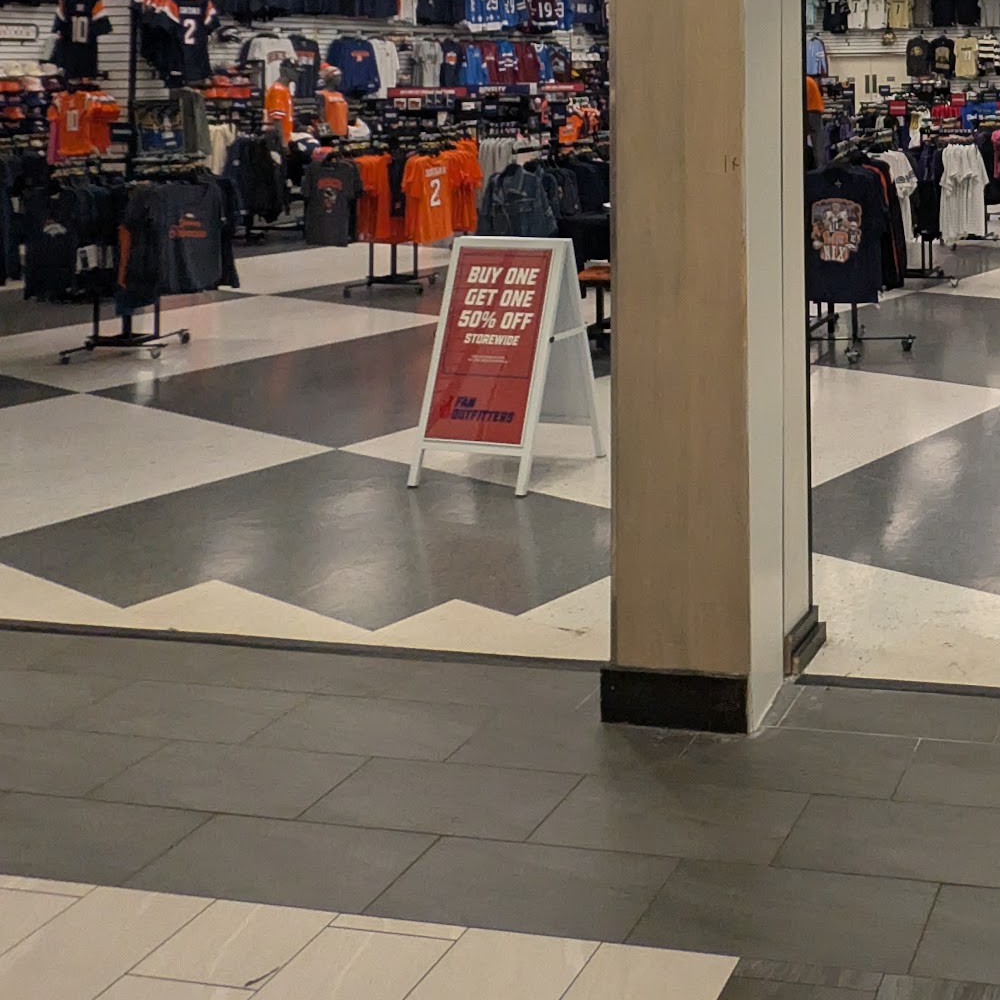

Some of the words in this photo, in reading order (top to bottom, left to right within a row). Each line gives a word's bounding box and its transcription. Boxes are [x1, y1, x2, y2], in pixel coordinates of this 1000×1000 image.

[72, 16, 89, 43] 10
[183, 18, 195, 45] 2
[430, 179, 441, 207] 2
[823, 245, 846, 263] NIX
[467, 266, 503, 284] BUY
[504, 267, 540, 285] ONE
[464, 288, 499, 306] GET
[499, 289, 535, 307] ONE
[457, 311, 497, 329] 50%
[500, 312, 534, 330] OFF
[463, 333, 520, 346] STOREWIDE
[454, 396, 476, 408] FAN
[451, 408, 515, 423] OUTFITTERS
